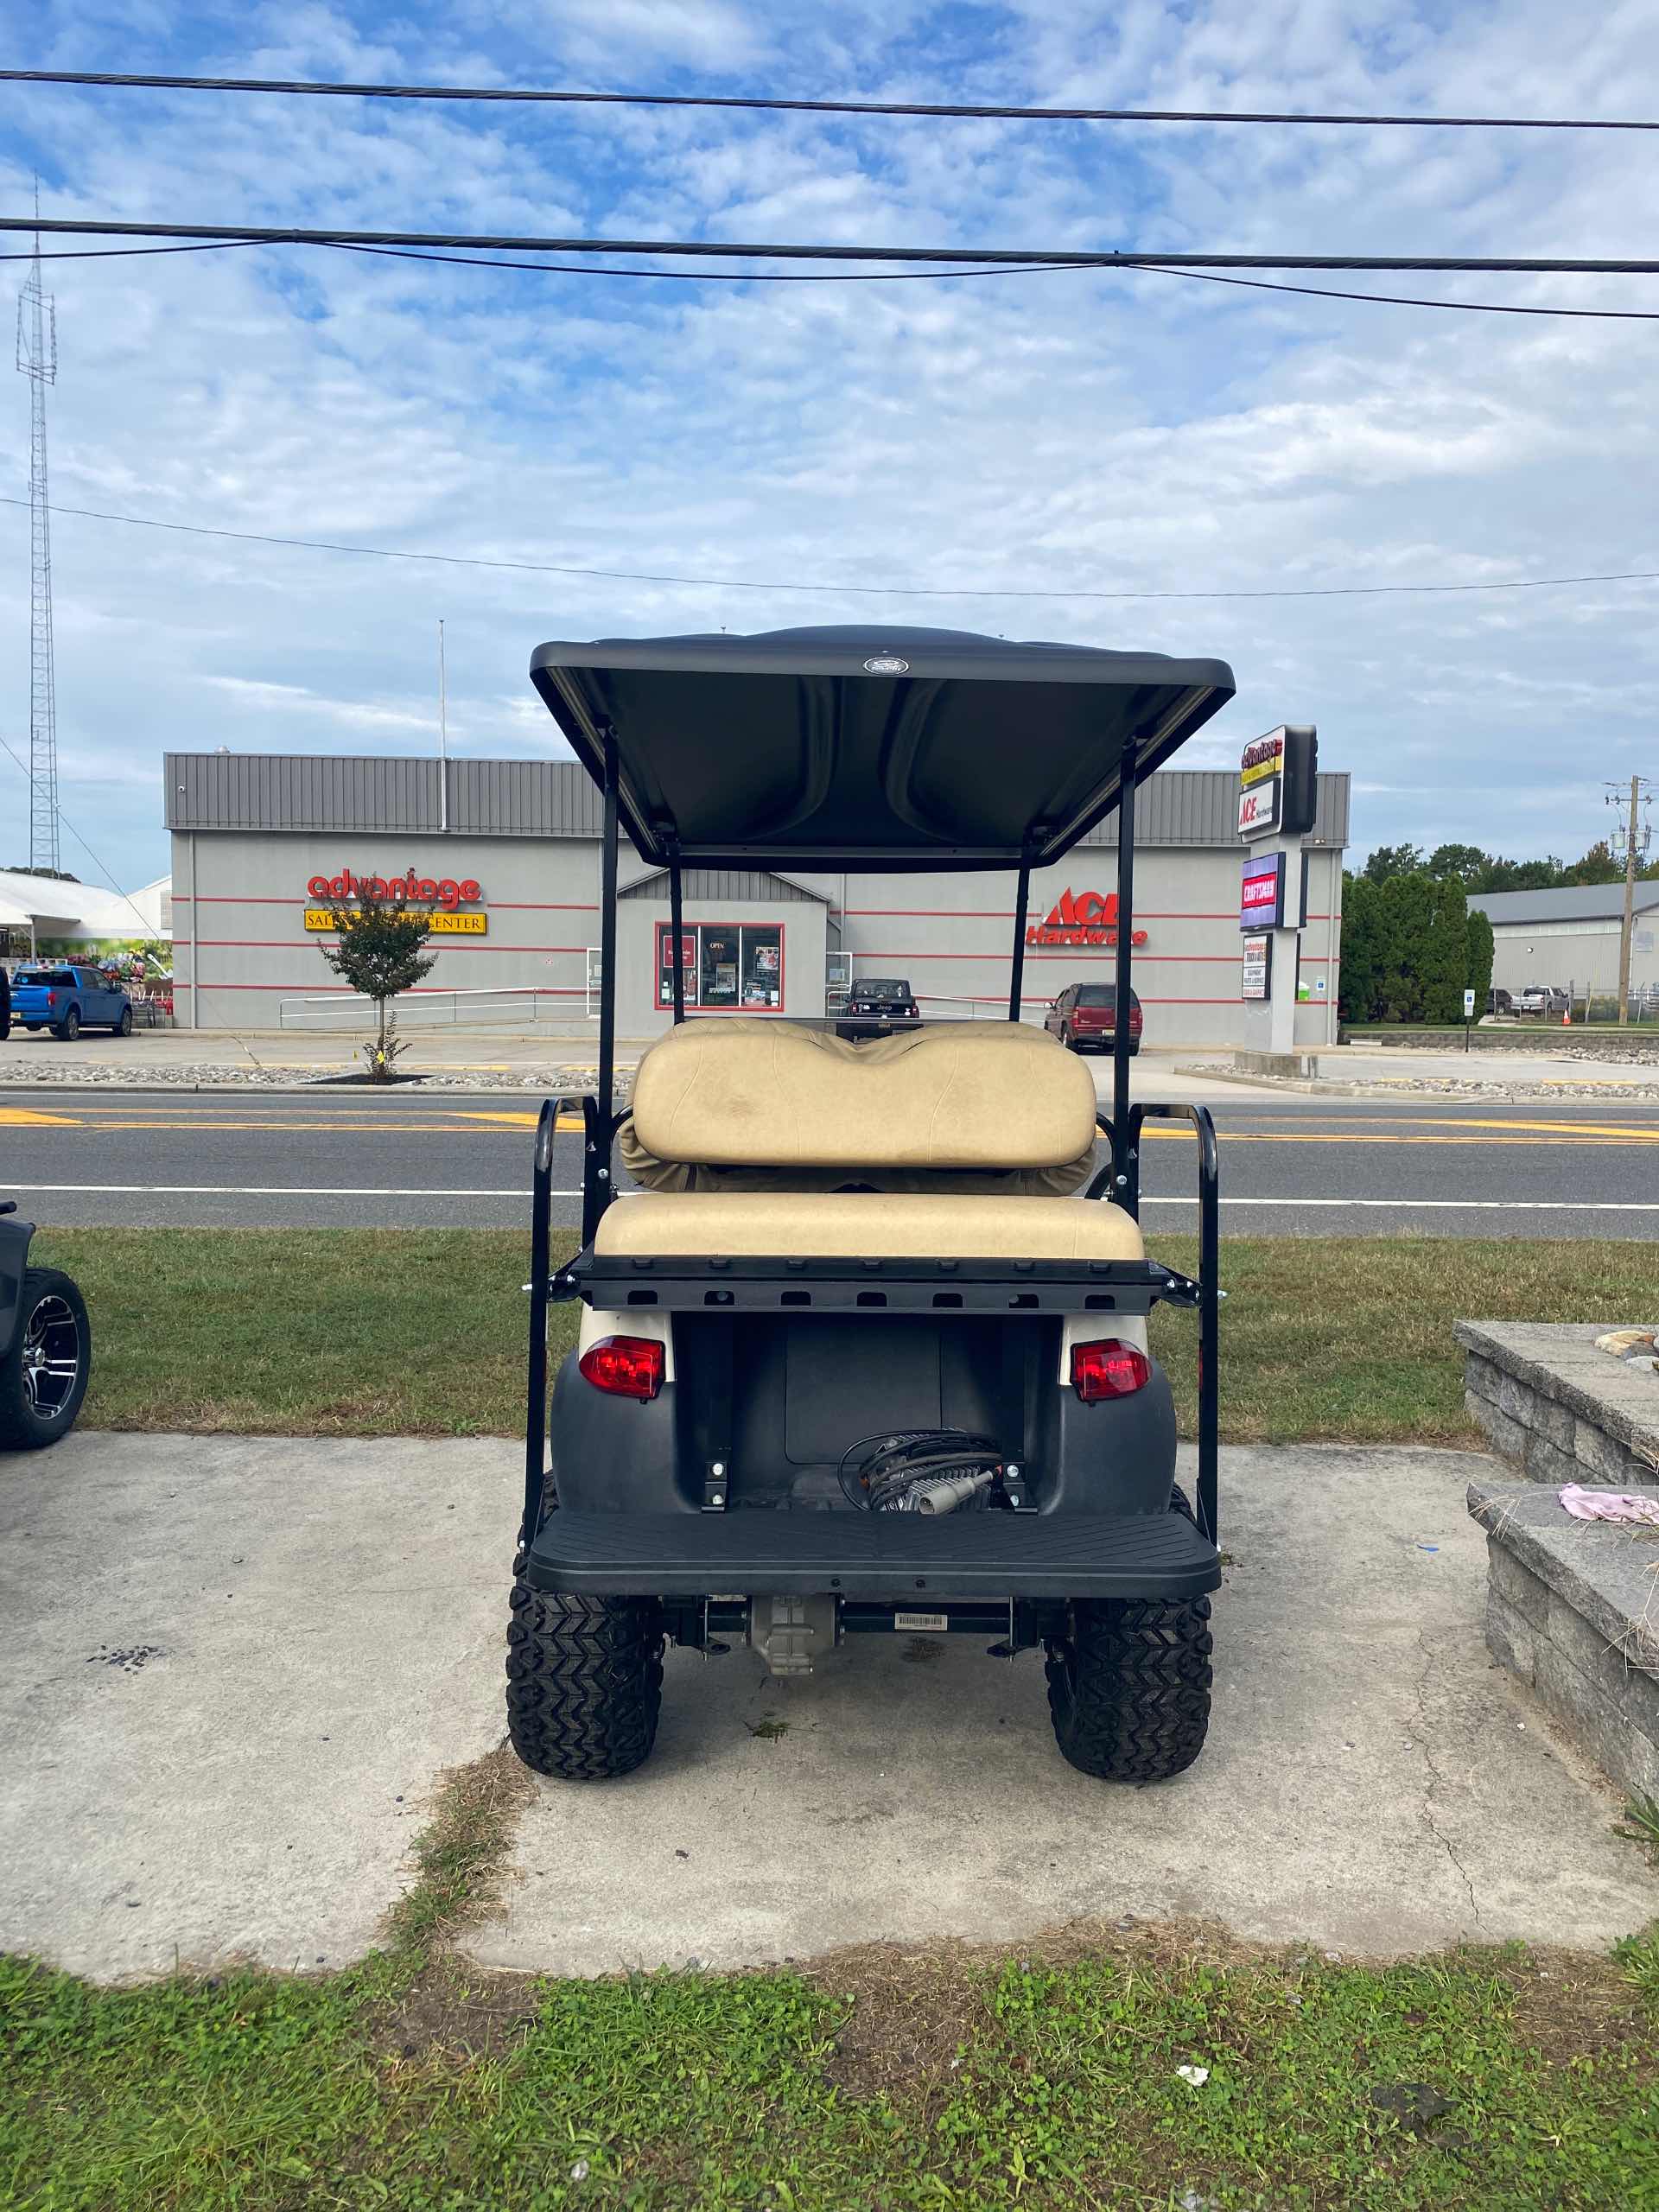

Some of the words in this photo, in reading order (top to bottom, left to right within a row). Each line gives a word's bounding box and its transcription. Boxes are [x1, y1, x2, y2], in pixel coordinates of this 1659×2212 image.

[1239, 796, 1258, 825] ACE
[307, 868, 482, 911] advantage
[1244, 879, 1274, 902] CRAFTSMAN
[1026, 925, 1148, 946] Hardwae
[877, 1003, 893, 1012] Jeep
